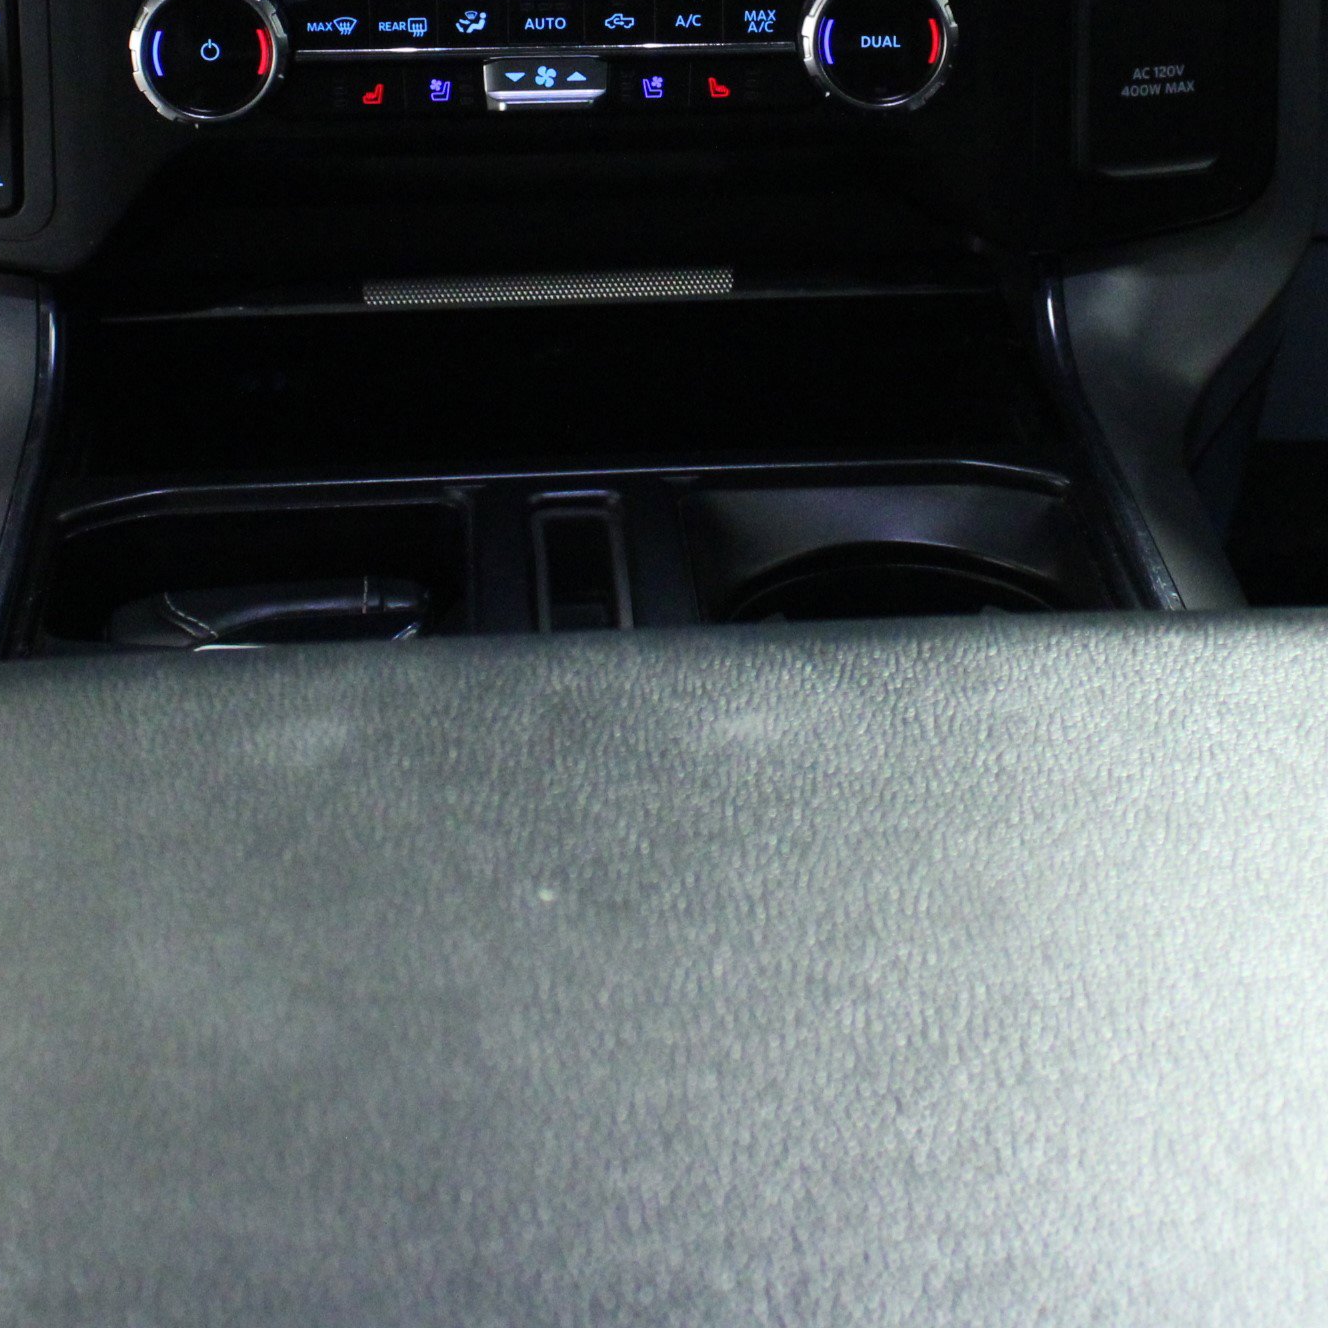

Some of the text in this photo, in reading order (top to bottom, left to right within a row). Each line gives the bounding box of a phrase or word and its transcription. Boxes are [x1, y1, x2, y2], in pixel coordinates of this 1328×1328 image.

[675, 14, 702, 28] A/C
[744, 10, 776, 22] MAX
[306, 21, 333, 32] MAX
[378, 21, 406, 32] REAR
[525, 17, 567, 30] AUTO
[747, 21, 774, 34] A/C
[860, 35, 901, 48] DUAL
[1132, 66, 1186, 80] AC 120V
[1121, 81, 1195, 97] 400W MAX
